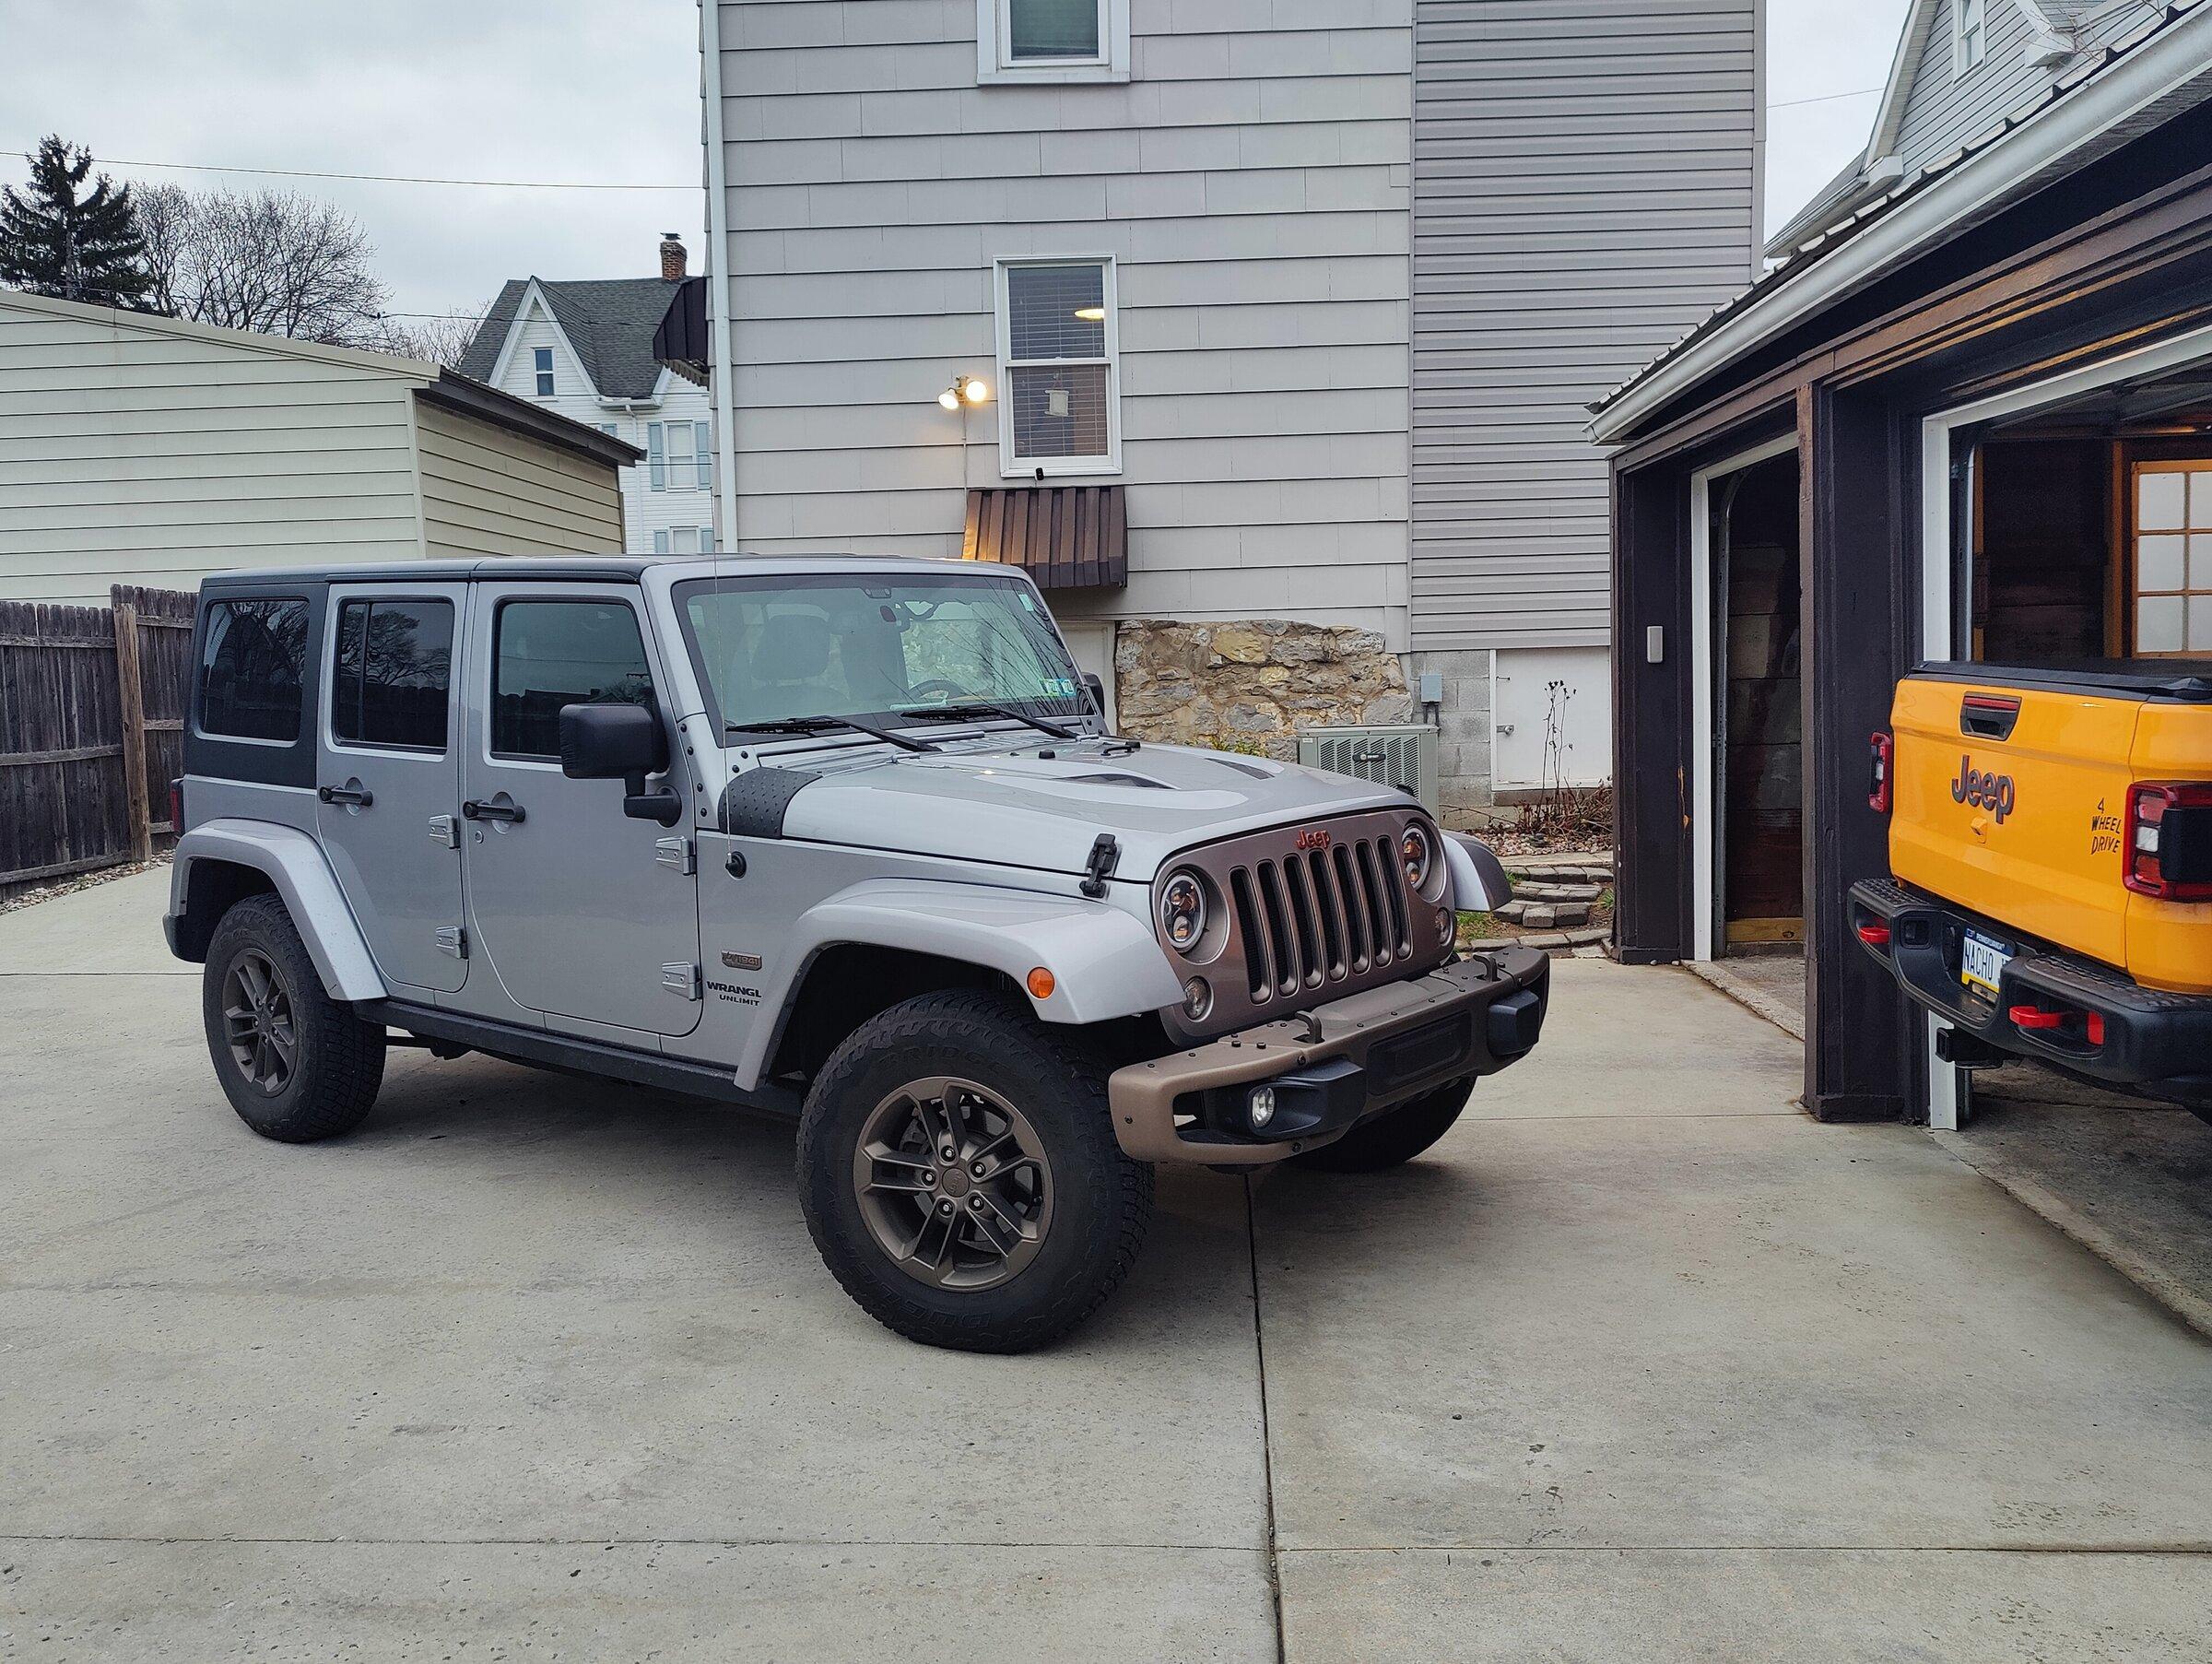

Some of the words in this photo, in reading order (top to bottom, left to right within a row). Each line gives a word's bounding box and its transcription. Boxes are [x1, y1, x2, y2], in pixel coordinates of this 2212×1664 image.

[1951, 754, 2015, 824] Jeep
[2097, 797, 2105, 814] 4
[2091, 815, 2122, 834] WHEEL
[1296, 828, 1331, 849] Jeep
[2090, 835, 2121, 855] DRIVE
[1963, 940, 1994, 981] NACHO
[706, 980, 762, 997] WRANGL
[719, 994, 760, 1006] UNLIMIT
